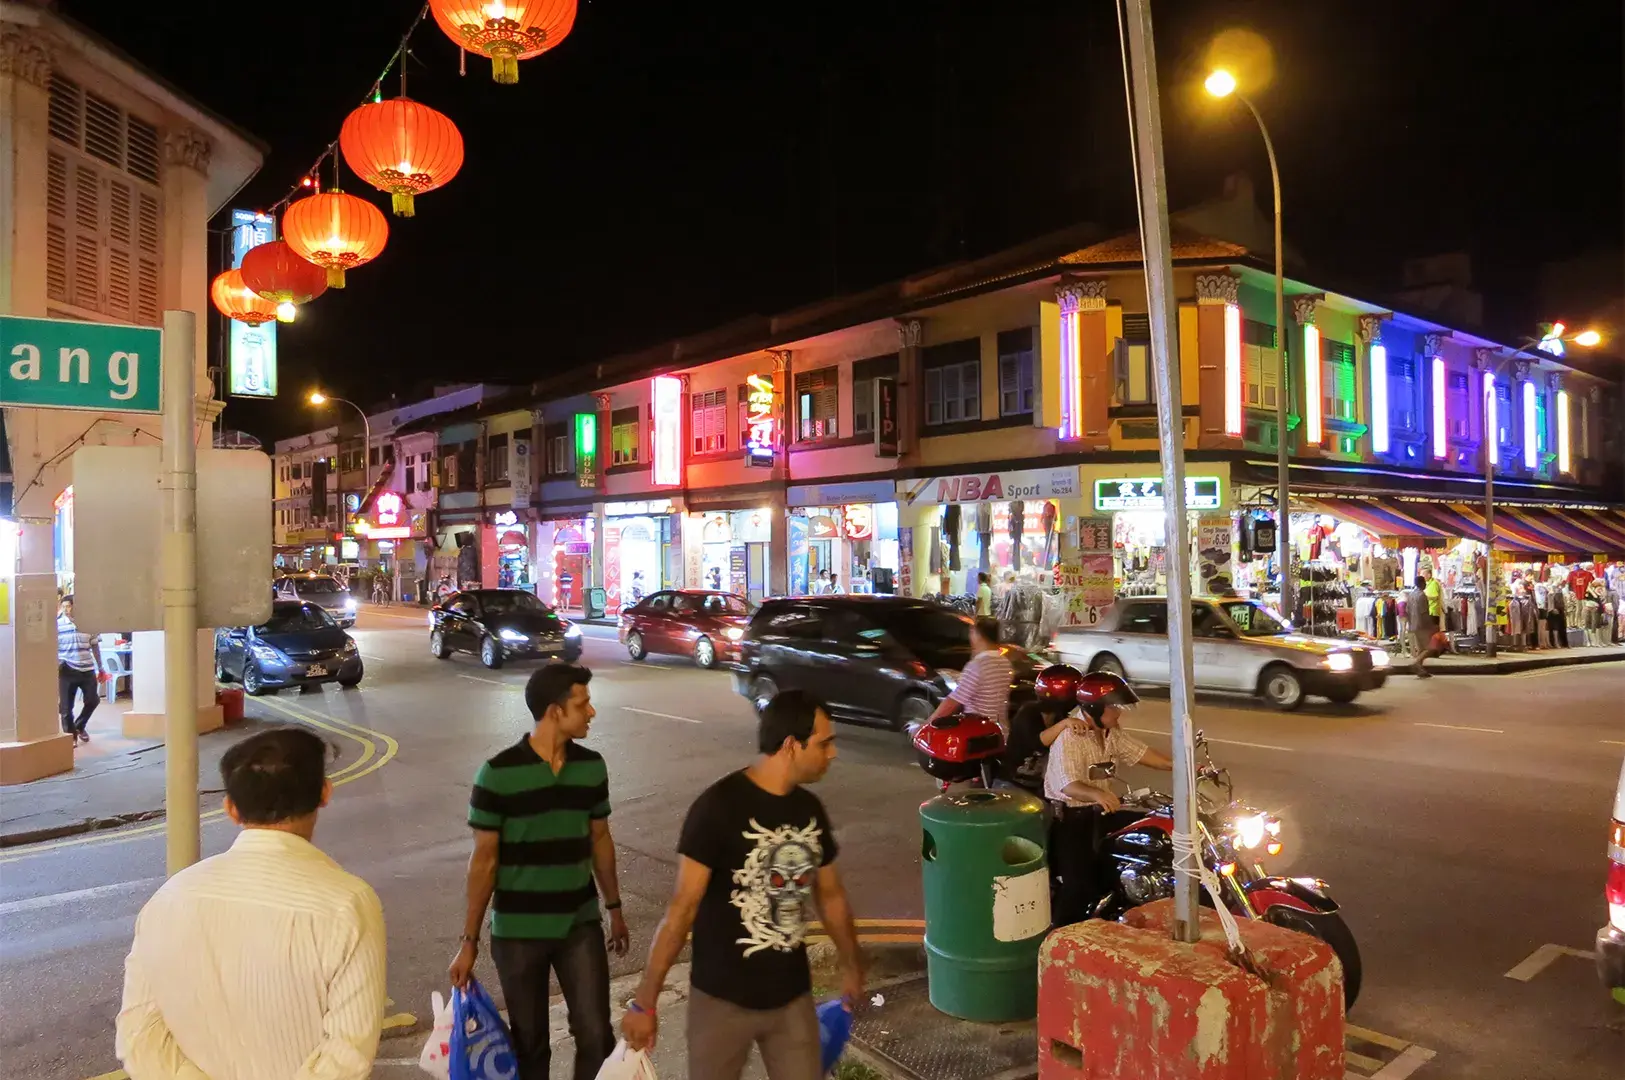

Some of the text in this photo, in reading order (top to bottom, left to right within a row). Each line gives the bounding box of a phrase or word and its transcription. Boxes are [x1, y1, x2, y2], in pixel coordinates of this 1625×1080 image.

[9, 343, 139, 400] ang
[937, 475, 1040, 502] NBA Sport
